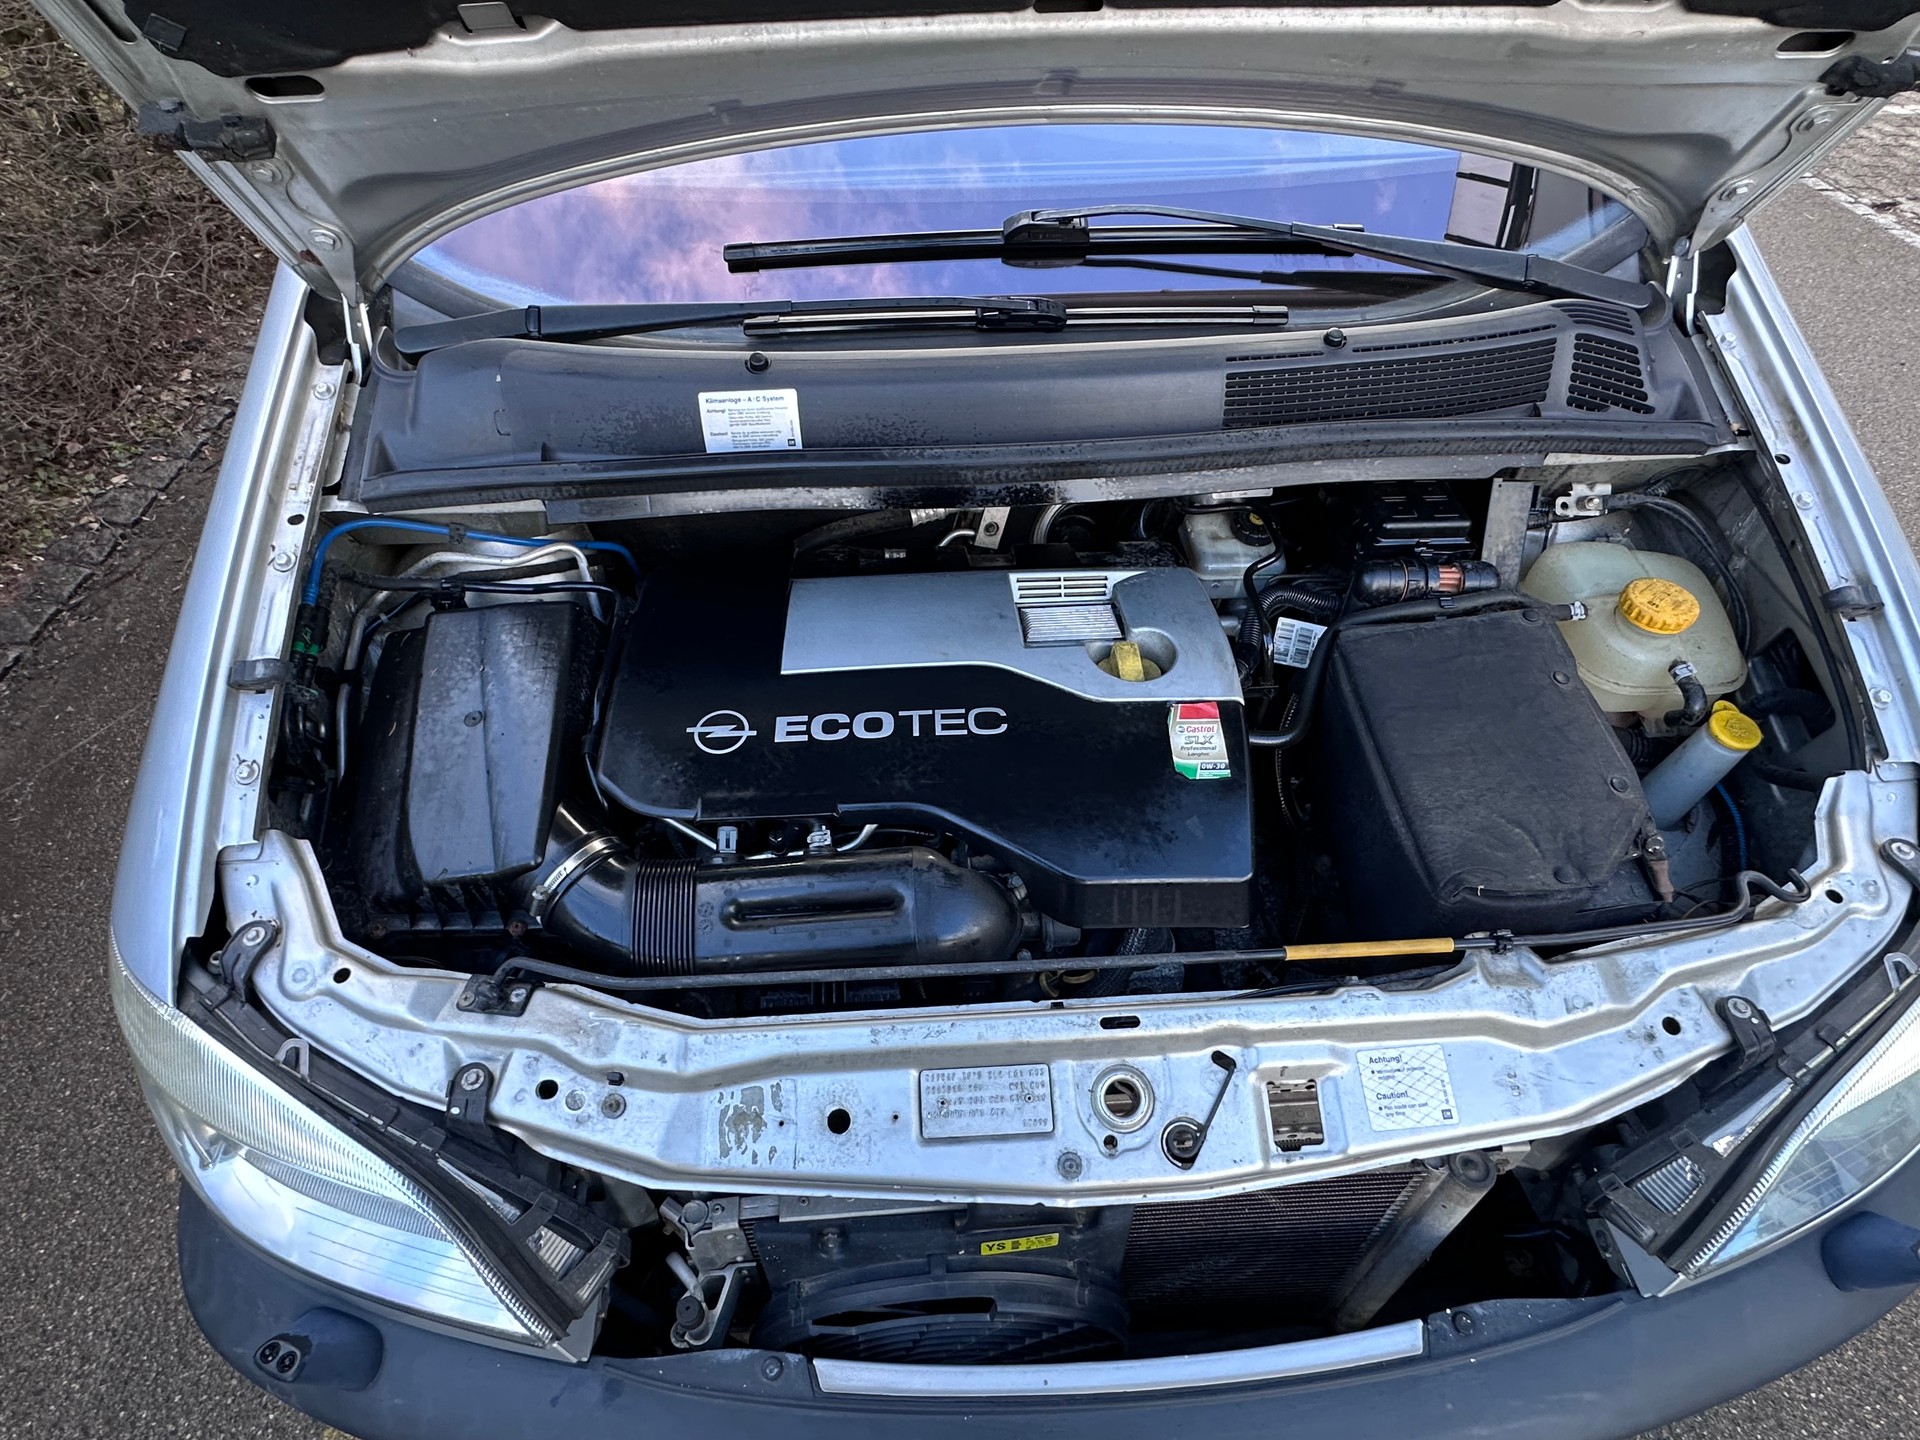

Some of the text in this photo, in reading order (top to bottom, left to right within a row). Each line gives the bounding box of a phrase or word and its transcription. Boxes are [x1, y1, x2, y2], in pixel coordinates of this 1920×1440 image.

[773, 707, 1008, 743] ECOTEC
[1186, 725, 1215, 733] Castrol
[1184, 735, 1214, 745] SLX
[1201, 762, 1226, 770] 0W-30
[1369, 1053, 1402, 1064] Achtung!
[1376, 1090, 1409, 1100] Caution!
[986, 1242, 1006, 1252] YS
